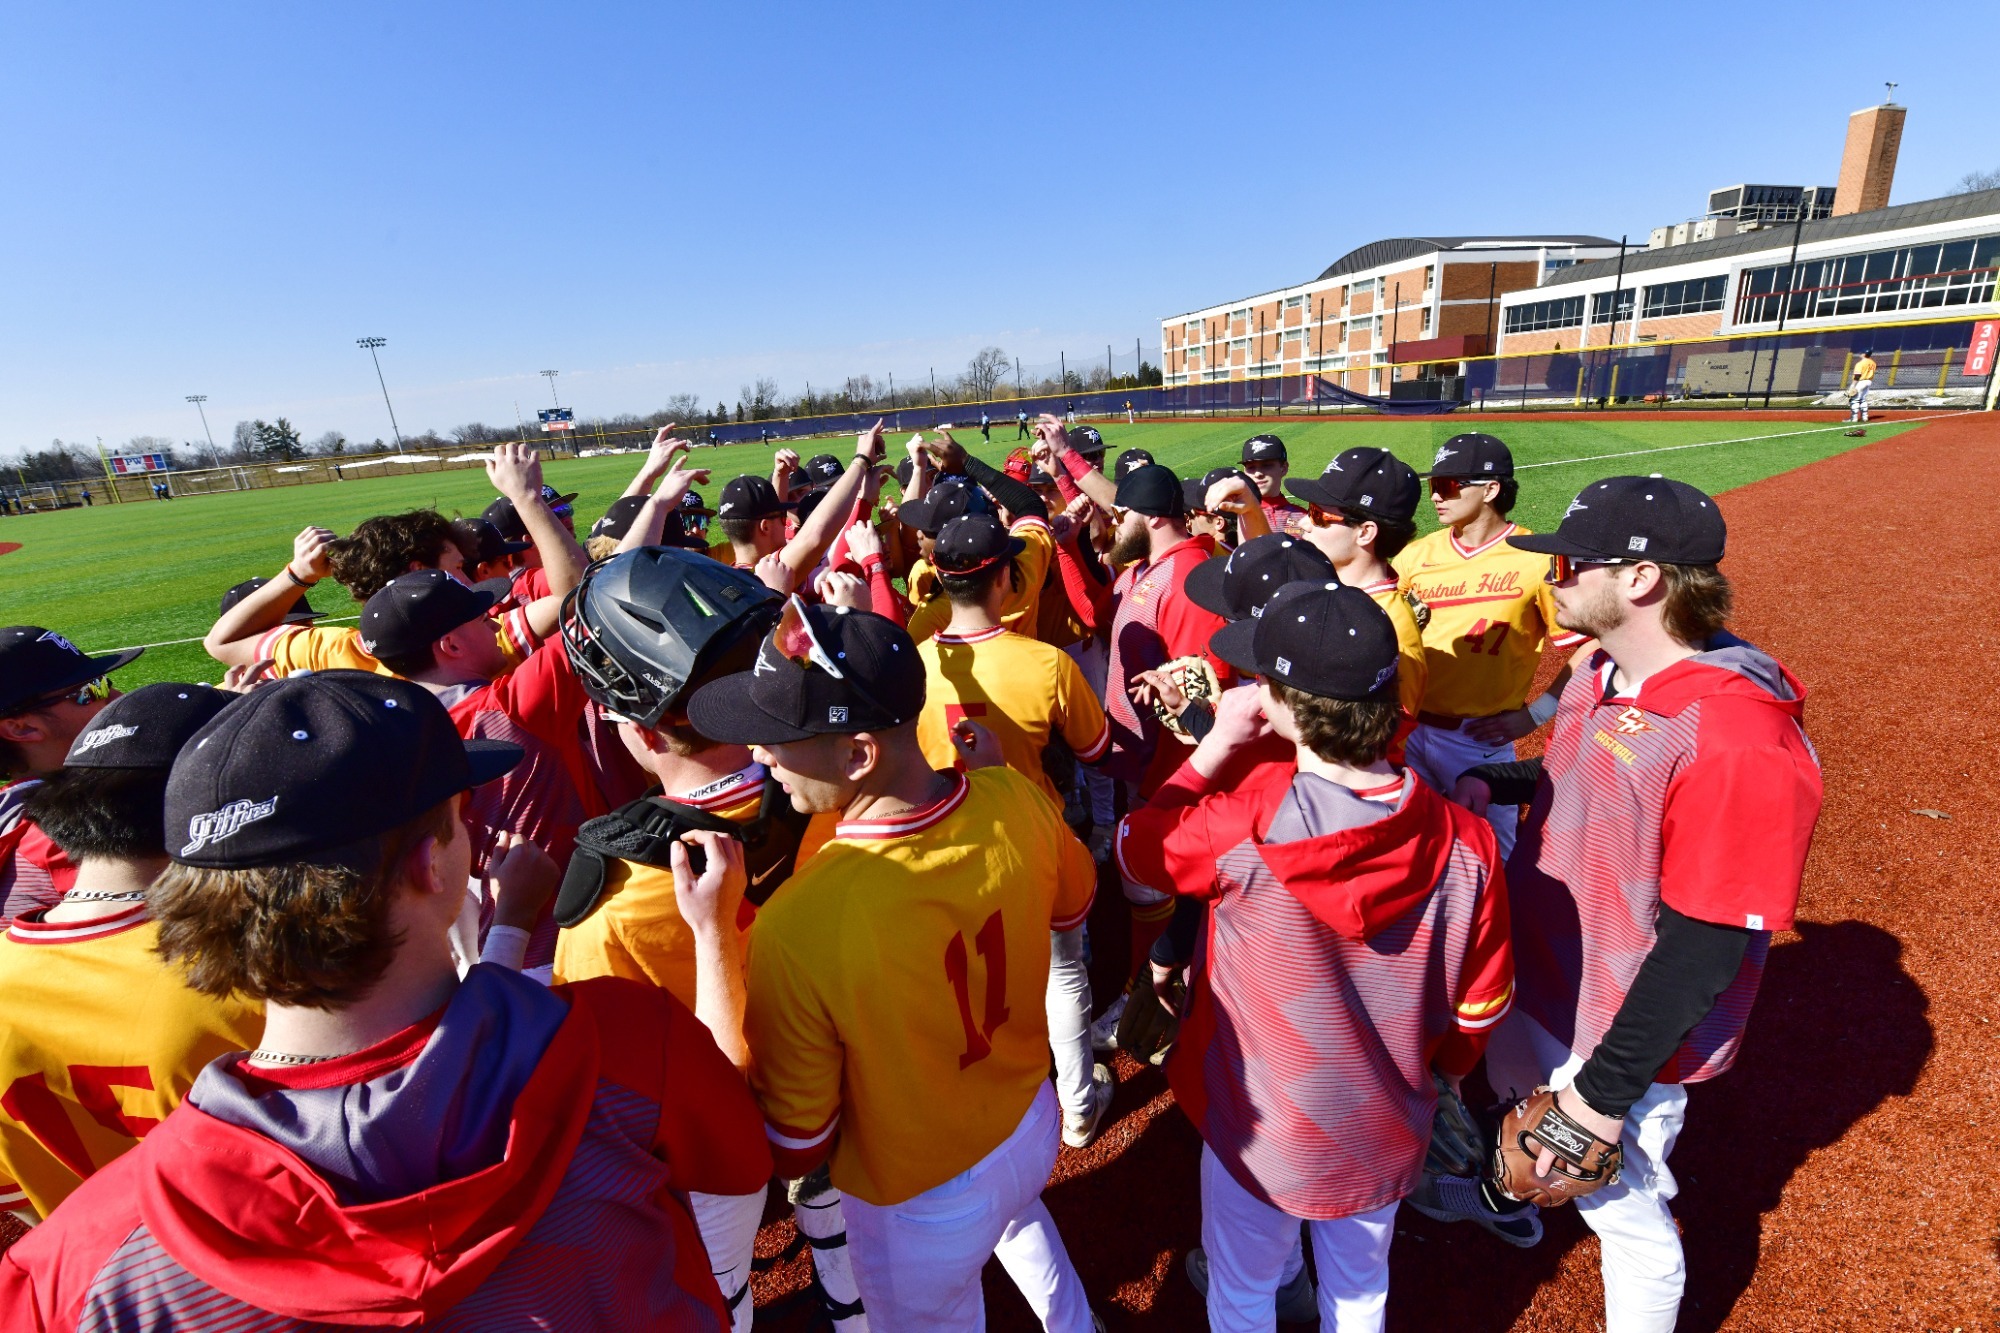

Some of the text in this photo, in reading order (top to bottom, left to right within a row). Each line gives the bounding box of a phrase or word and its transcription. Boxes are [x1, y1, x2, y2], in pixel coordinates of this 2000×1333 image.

[1971, 324, 1993, 370] 320
[1475, 571, 1523, 593] Hill
[1463, 617, 1511, 656] 47
[1594, 729, 1637, 766] BASEBALL
[688, 773, 745, 799] NIKE PRO
[181, 795, 279, 857] griffins
[944, 908, 1011, 1072] 11
